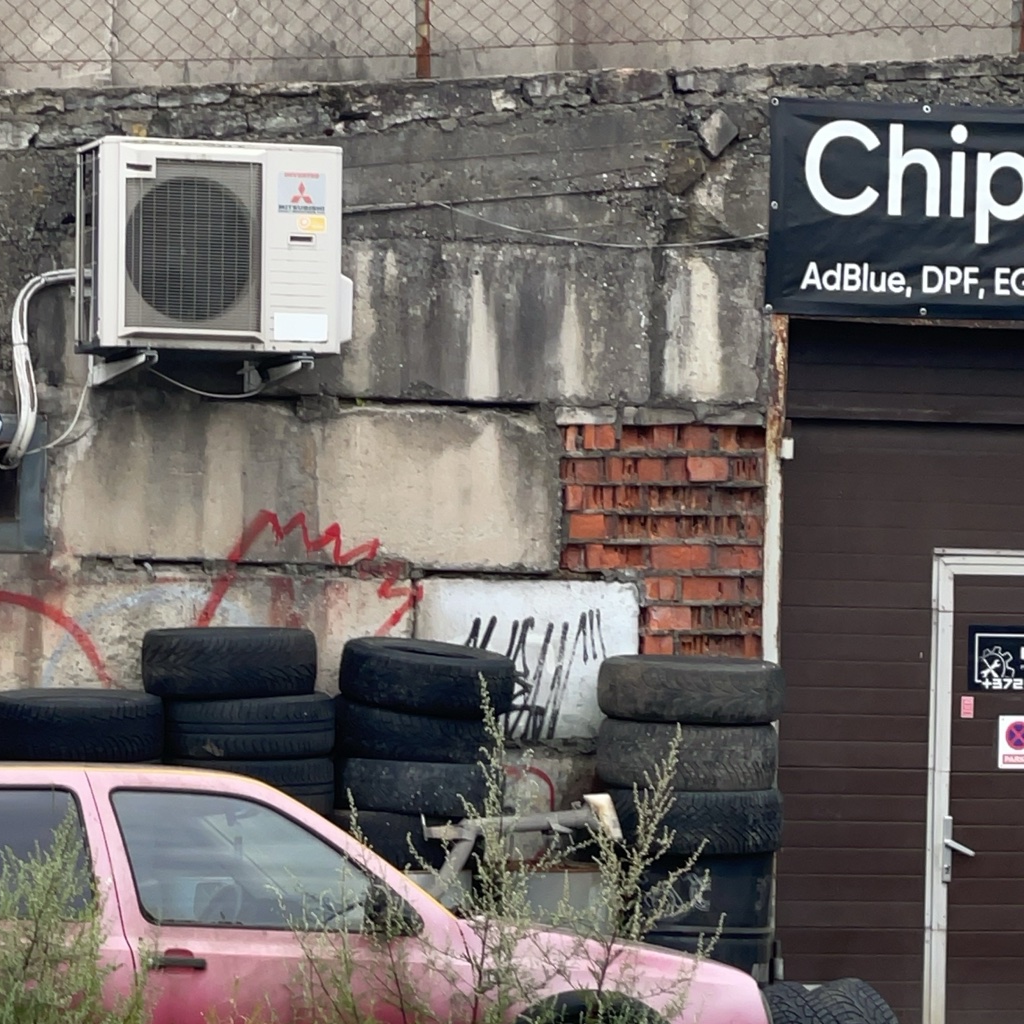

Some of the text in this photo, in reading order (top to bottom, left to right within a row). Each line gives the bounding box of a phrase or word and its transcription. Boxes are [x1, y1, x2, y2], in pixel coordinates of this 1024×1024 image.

[805, 119, 1024, 244] Chip
[800, 261, 912, 298] AdBlue,
[922, 265, 985, 300] DPF,
[982, 678, 1024, 690] +372
